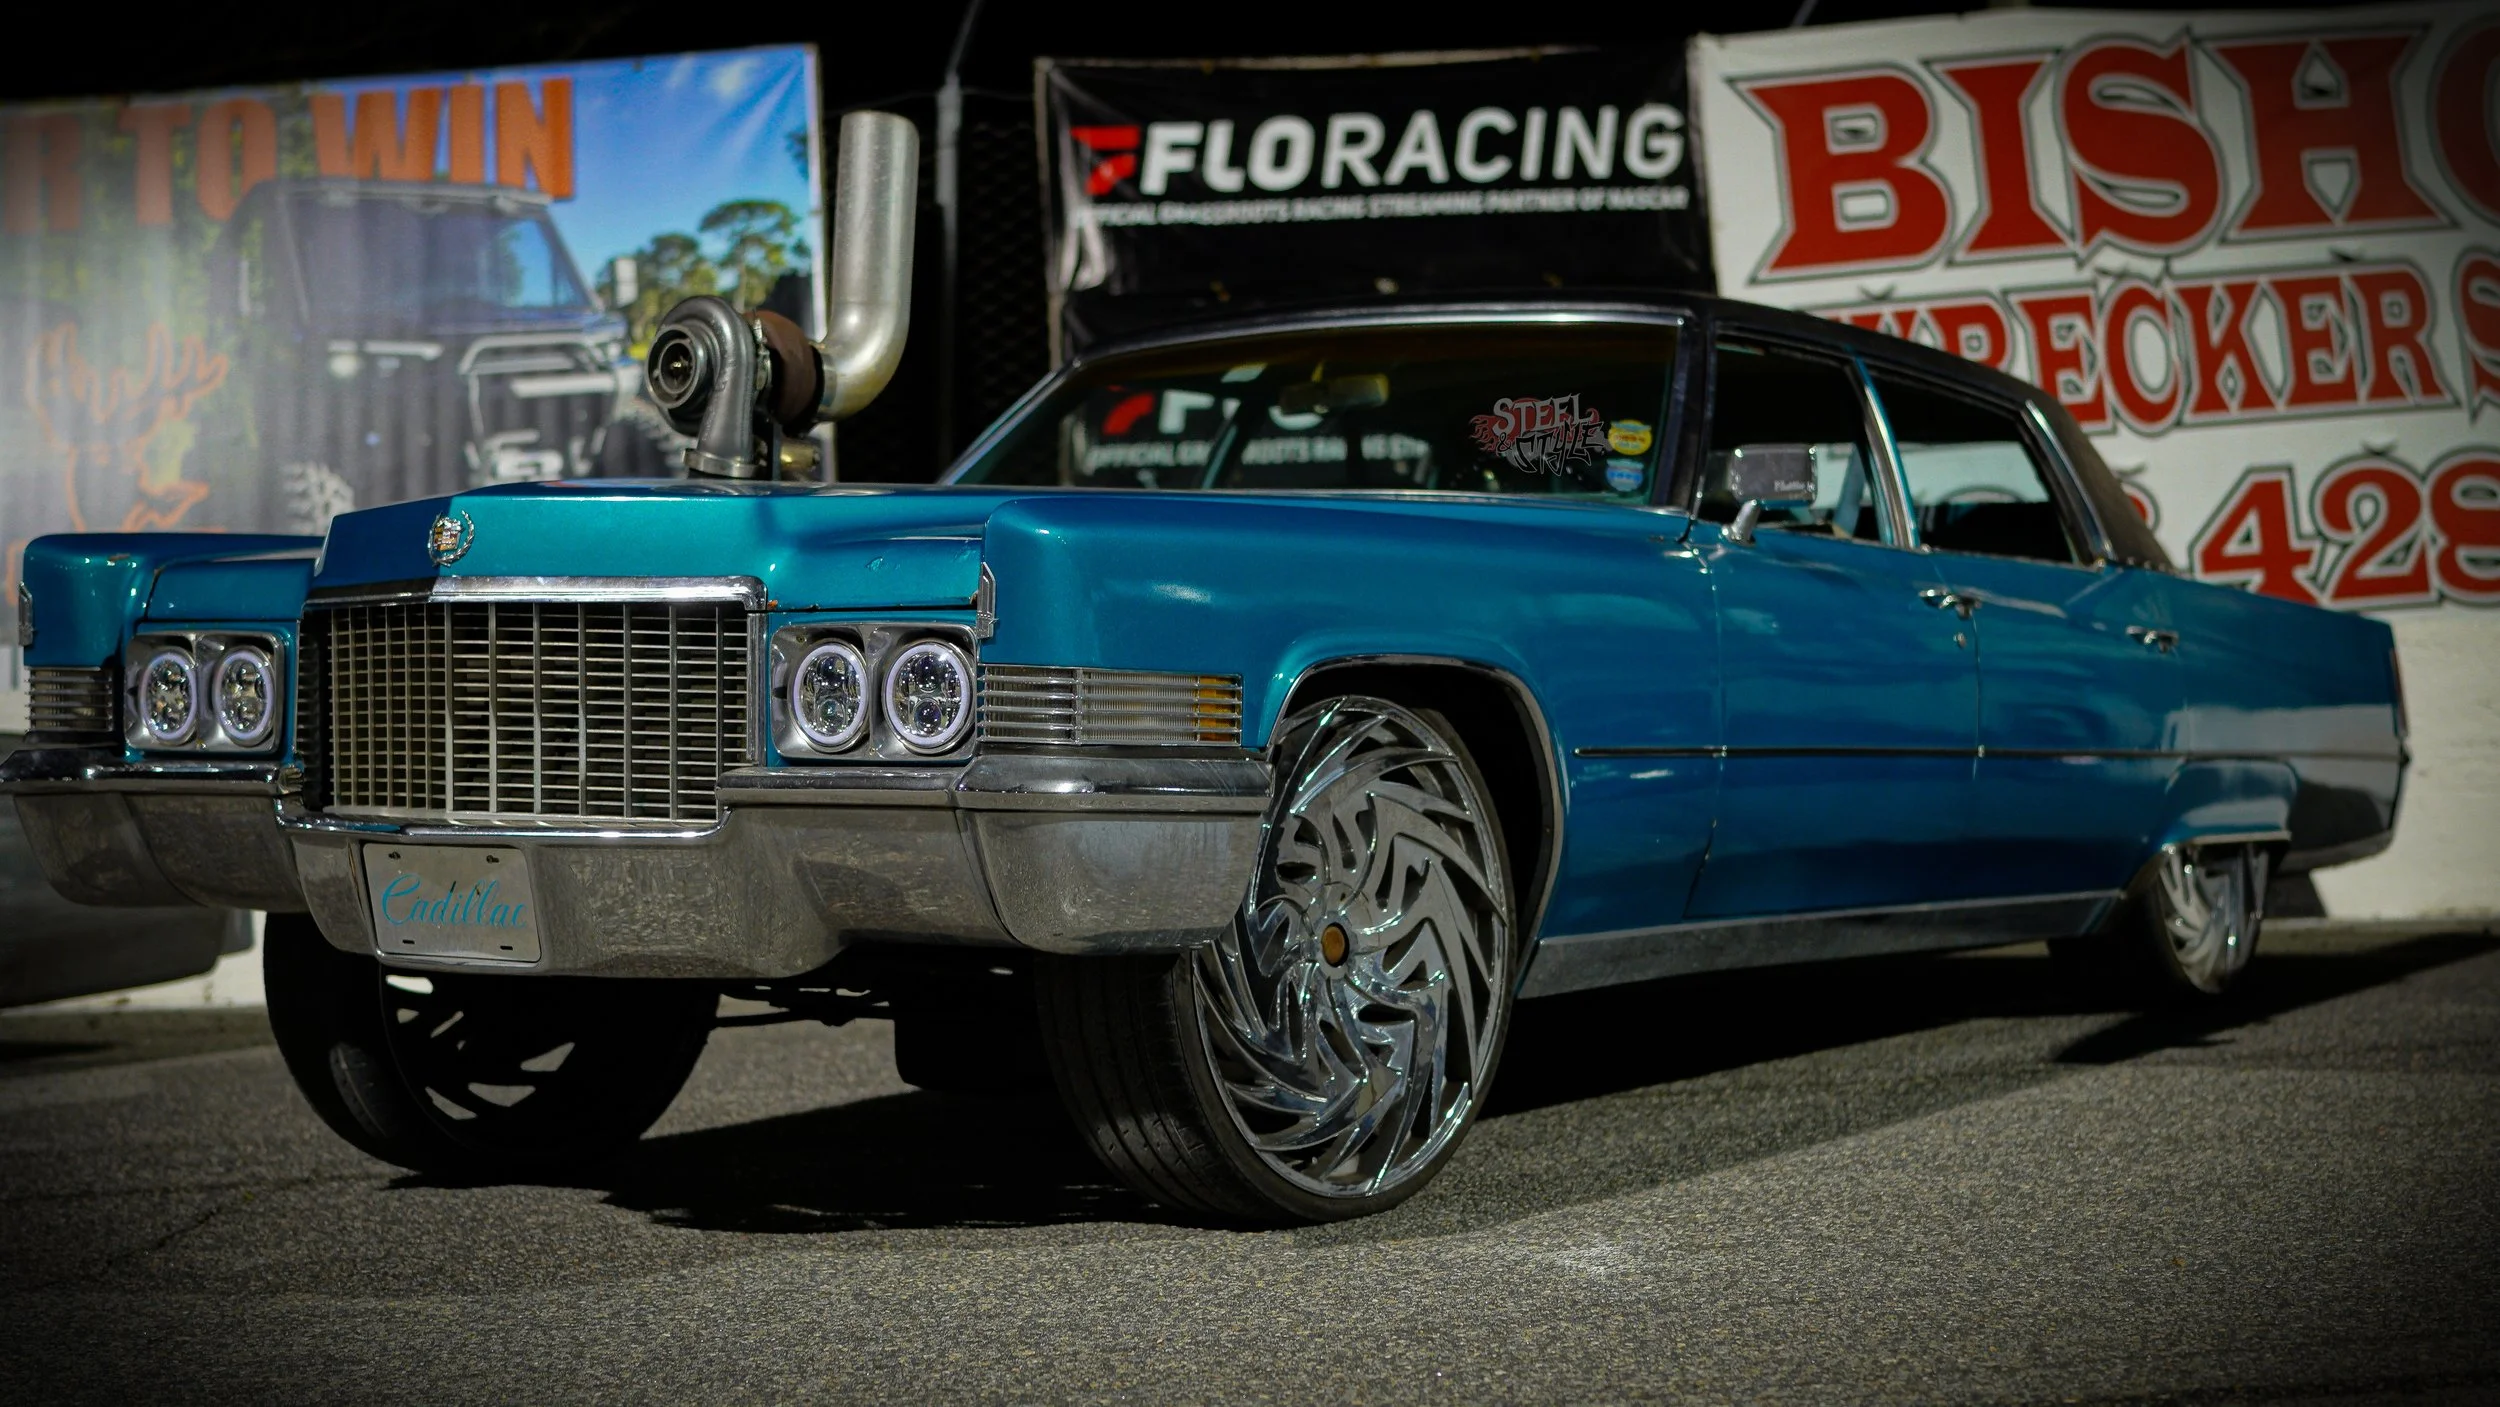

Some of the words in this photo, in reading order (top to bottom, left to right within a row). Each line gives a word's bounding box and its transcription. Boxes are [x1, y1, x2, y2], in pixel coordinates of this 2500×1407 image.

[118, 98, 278, 222] TO
[310, 76, 574, 199] WIN
[1140, 103, 1685, 196] FLORACING
[1491, 393, 1592, 438] STEEL
[1497, 432, 1512, 453] &
[1505, 420, 1604, 477] STYLE
[382, 873, 529, 930] Cadillac
